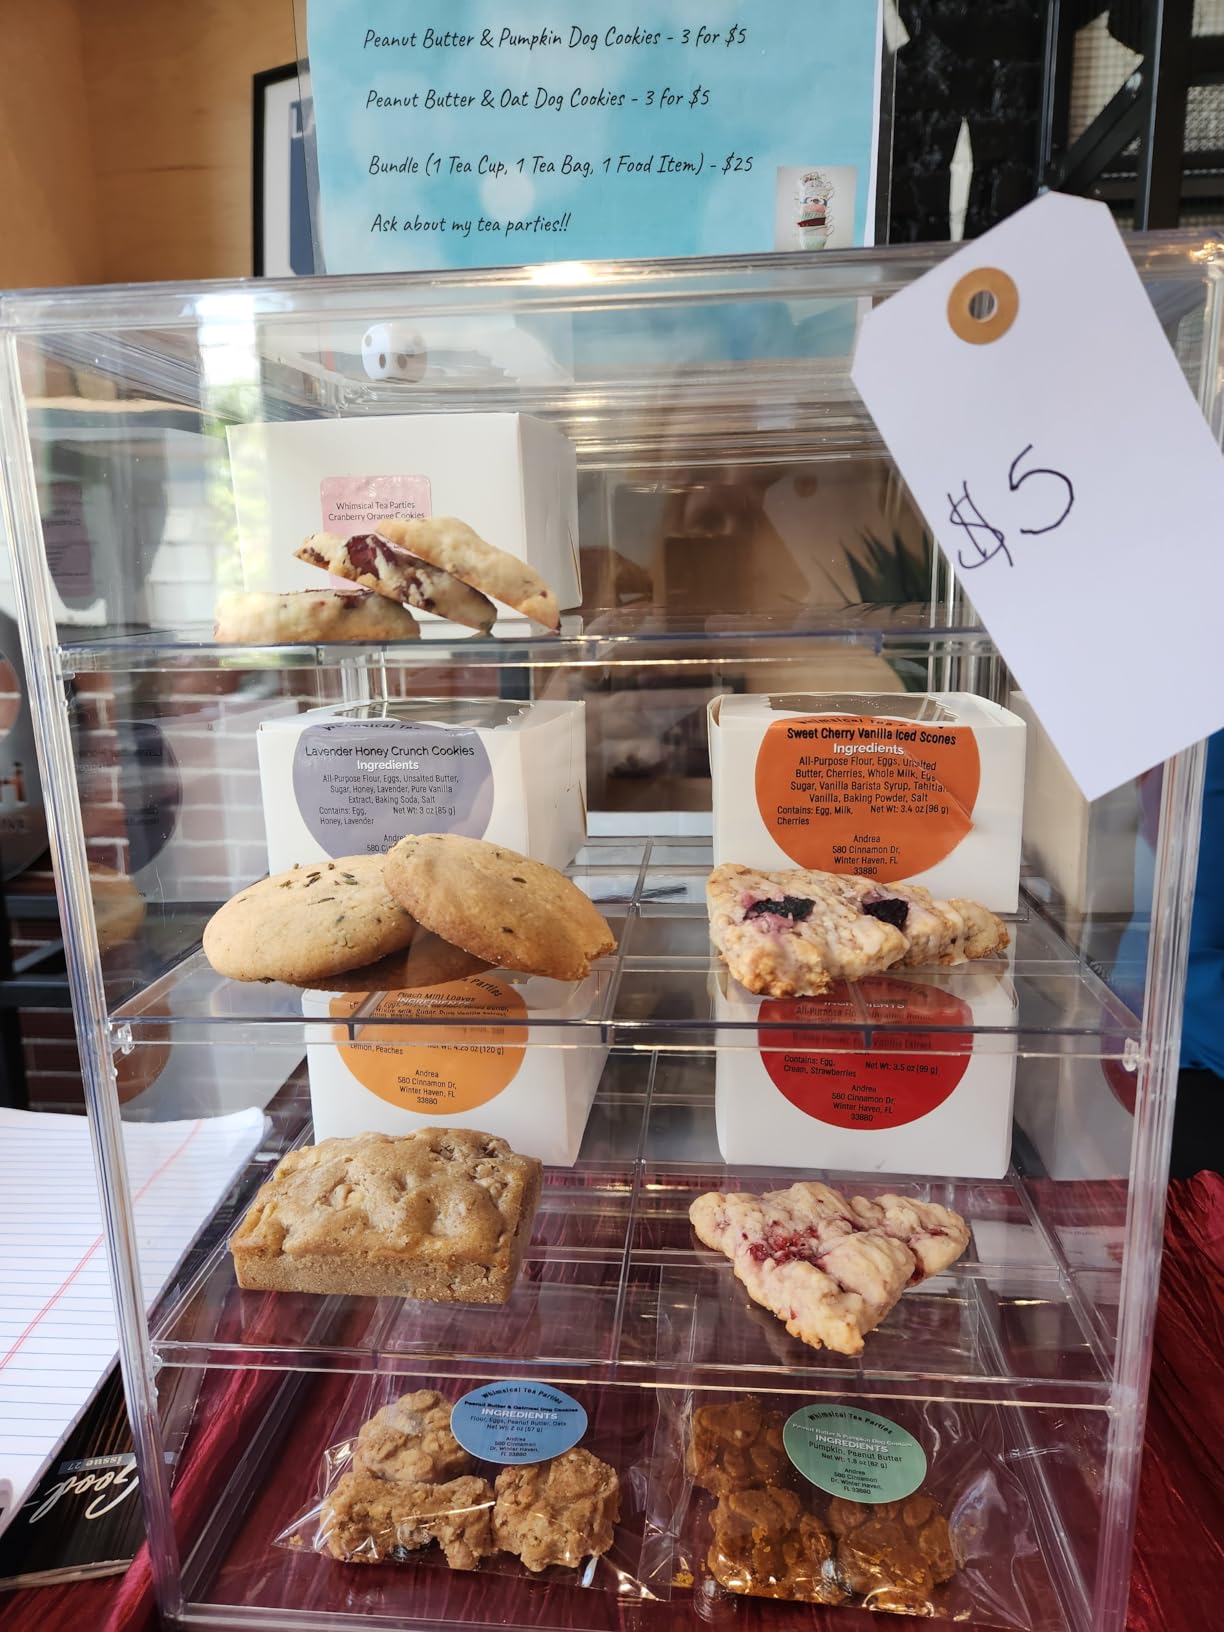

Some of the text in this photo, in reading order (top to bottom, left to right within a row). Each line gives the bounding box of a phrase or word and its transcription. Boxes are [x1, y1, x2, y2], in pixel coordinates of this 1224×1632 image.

[363, 29, 417, 49] Peanut
[422, 28, 474, 48] Butter
[479, 28, 494, 48] &
[499, 27, 562, 50] Pumpkin
[568, 25, 598, 50] Dog
[604, 26, 661, 47] Cookies
[680, 28, 691, 45] 3
[695, 25, 720, 47] for
[724, 23, 747, 47] $5
[365, 89, 419, 109] Peanut
[424, 88, 475, 109] Butter
[480, 89, 495, 109] &
[500, 88, 529, 107] Oat
[533, 87, 564, 111] Dog
[570, 87, 626, 107] Cookies
[645, 90, 655, 106] 3
[659, 87, 684, 109] for
[688, 84, 711, 109] $5
[368, 155, 419, 175] Bundle
[425, 152, 442, 177] (1
[448, 155, 472, 175] Tea
[477, 154, 508, 178] Cup,
[515, 158, 525, 173] 1
[532, 155, 556, 174] Tea
[560, 154, 594, 178] Bag,
[602, 157, 611, 173] 1
[616, 154, 654, 173] Food
[656, 152, 704, 176] Item)
[721, 151, 754, 175] $25
[370, 212, 571, 238] Ask about my tea parties!!
[335, 500, 416, 510] Whimsical Tea Parties
[947, 443, 1075, 570] $5
[328, 513, 365, 521] Cranberry
[395, 511, 425, 519] Cookies
[787, 727, 957, 745] Sweet Cherry Vanilla Iced Scones
[305, 745, 475, 758] Lavender Honey Crunch Cookies
[833, 742, 905, 756] Ingredients
[357, 759, 419, 772] Ingredients
[799, 756, 848, 767] All-Purpose
[850, 756, 875, 766] Flour,
[877, 756, 900, 768] Eggs,
[322, 774, 459, 784] All-Purpose Flour, Eggs, Unsalted Butter,
[795, 768, 824, 778] Butter,
[826, 768, 865, 778] Cherries,
[867, 769, 895, 778] Whole
[896, 769, 918, 780] Milk,
[352, 785, 376, 794] Honey,
[377, 785, 410, 794] Lavender,
[411, 785, 427, 793] Pure
[428, 785, 453, 793] Vanilla
[790, 781, 817, 792] Sugar,
[819, 781, 849, 791] Vanilla
[851, 781, 881, 791] Barista
[883, 781, 911, 792] Syrup,
[348, 795, 436, 805] Extract, Baking Soda, Salt
[809, 793, 928, 804] Vanilla, Baking Powder, Salt
[318, 806, 367, 816] Contains: Egg,
[393, 806, 405, 814] Net
[406, 806, 418, 814] Wt:
[419, 806, 424, 814] 3
[777, 805, 853, 816] Contains: Egg, Milk,
[870, 805, 884, 813] Net
[886, 805, 899, 813] Wt:
[900, 805, 913, 813] 3.4
[320, 817, 374, 826] Honey, Lavender
[777, 816, 810, 825] Cherries
[853, 834, 881, 843] Andrea
[832, 845, 847, 854] 580
[848, 845, 888, 854] Cinnamon
[833, 856, 860, 865] Winter
[889, 856, 898, 865] FL
[853, 866, 878, 875] 33880
[375, 1045, 404, 1055] Peaches
[784, 1054, 818, 1065] Contains:
[865, 1061, 878, 1069] Net
[892, 1063, 905, 1071] 3.5
[415, 1069, 440, 1078] Andrea
[810, 1066, 857, 1078] Strawberries
[397, 1076, 411, 1084] 580
[411, 1077, 446, 1088] Cinnamon
[399, 1085, 422, 1095] Winter
[447, 1090, 456, 1098] FL
[416, 1096, 438, 1105] 33880
[832, 1102, 857, 1111] Winter
[482, 1387, 563, 1405] Whimsical Tea Parties
[481, 1408, 558, 1420] INGREDIENTS
[808, 1410, 893, 1435] Whimsical Tea Parties
[815, 1434, 889, 1453] INGREDIENTS
[808, 1441, 903, 1463] Pumpkin, Peanut Butter
[67, 1455, 123, 1471] issue 27
